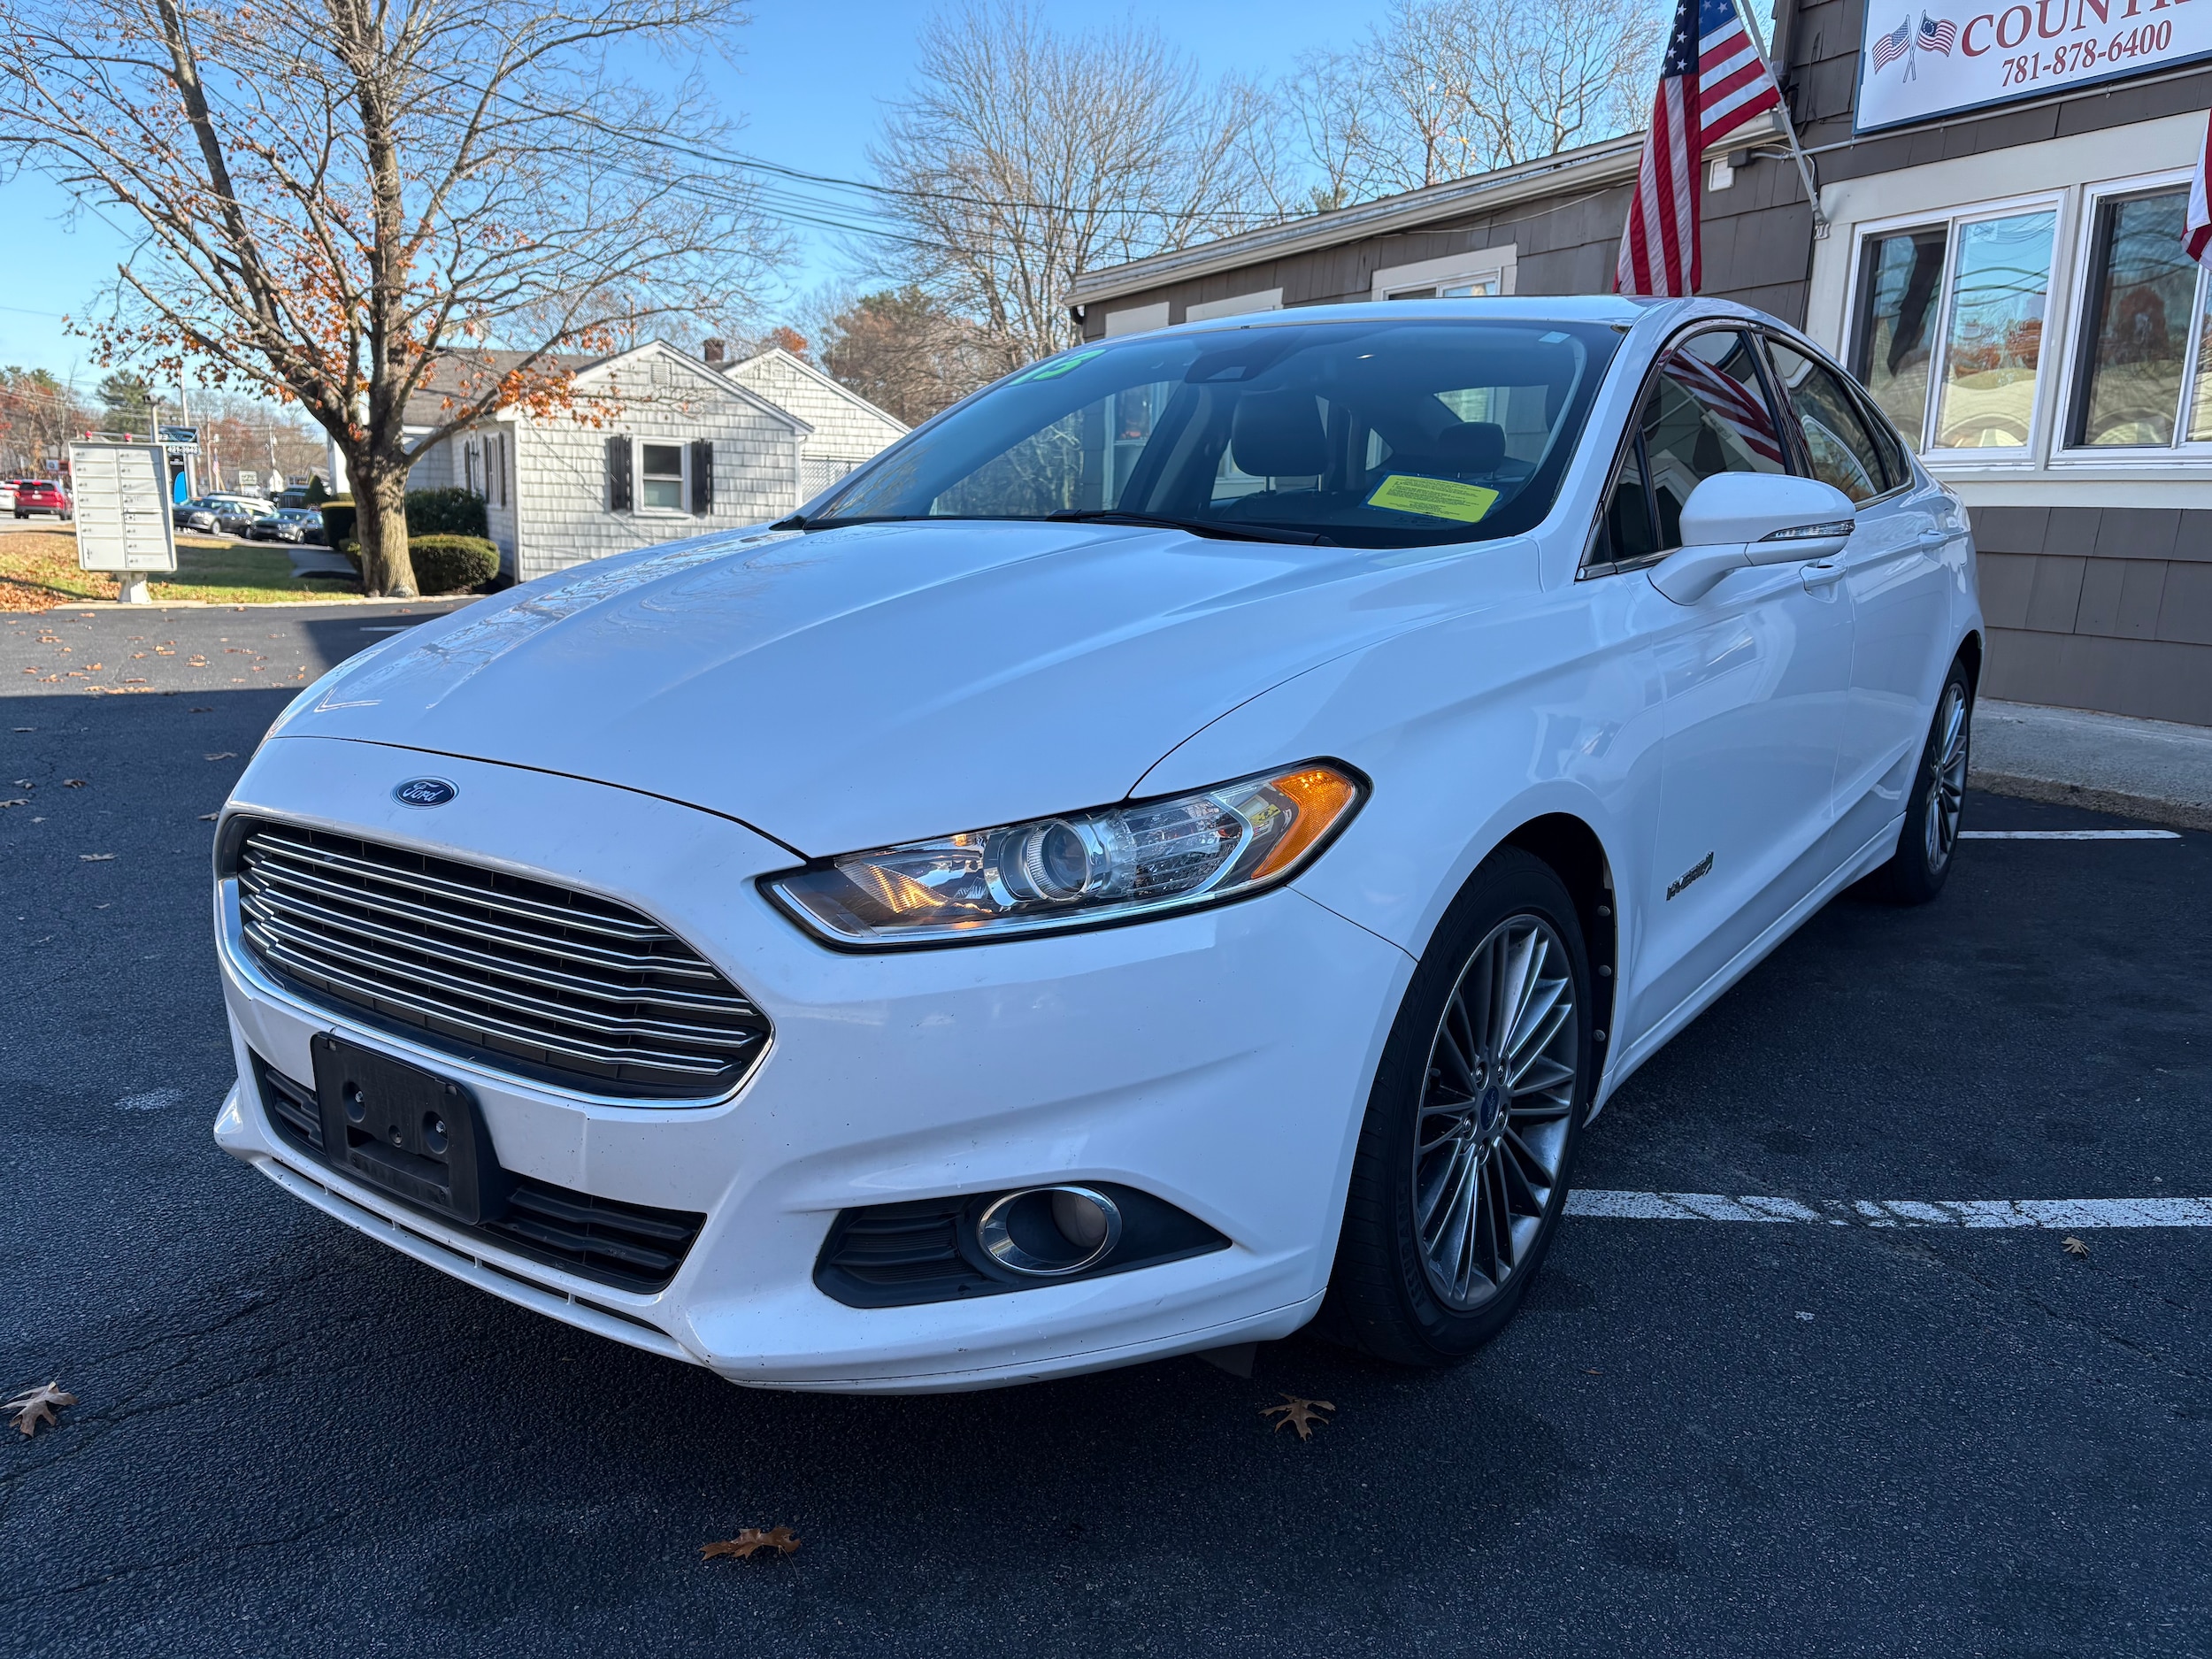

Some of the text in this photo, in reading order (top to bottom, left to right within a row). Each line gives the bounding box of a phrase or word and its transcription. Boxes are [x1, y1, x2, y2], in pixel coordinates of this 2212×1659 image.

[1962, 0, 2193, 57] COUN
[2001, 20, 2172, 87] 781-878-6400
[403, 781, 443, 802] Ford
